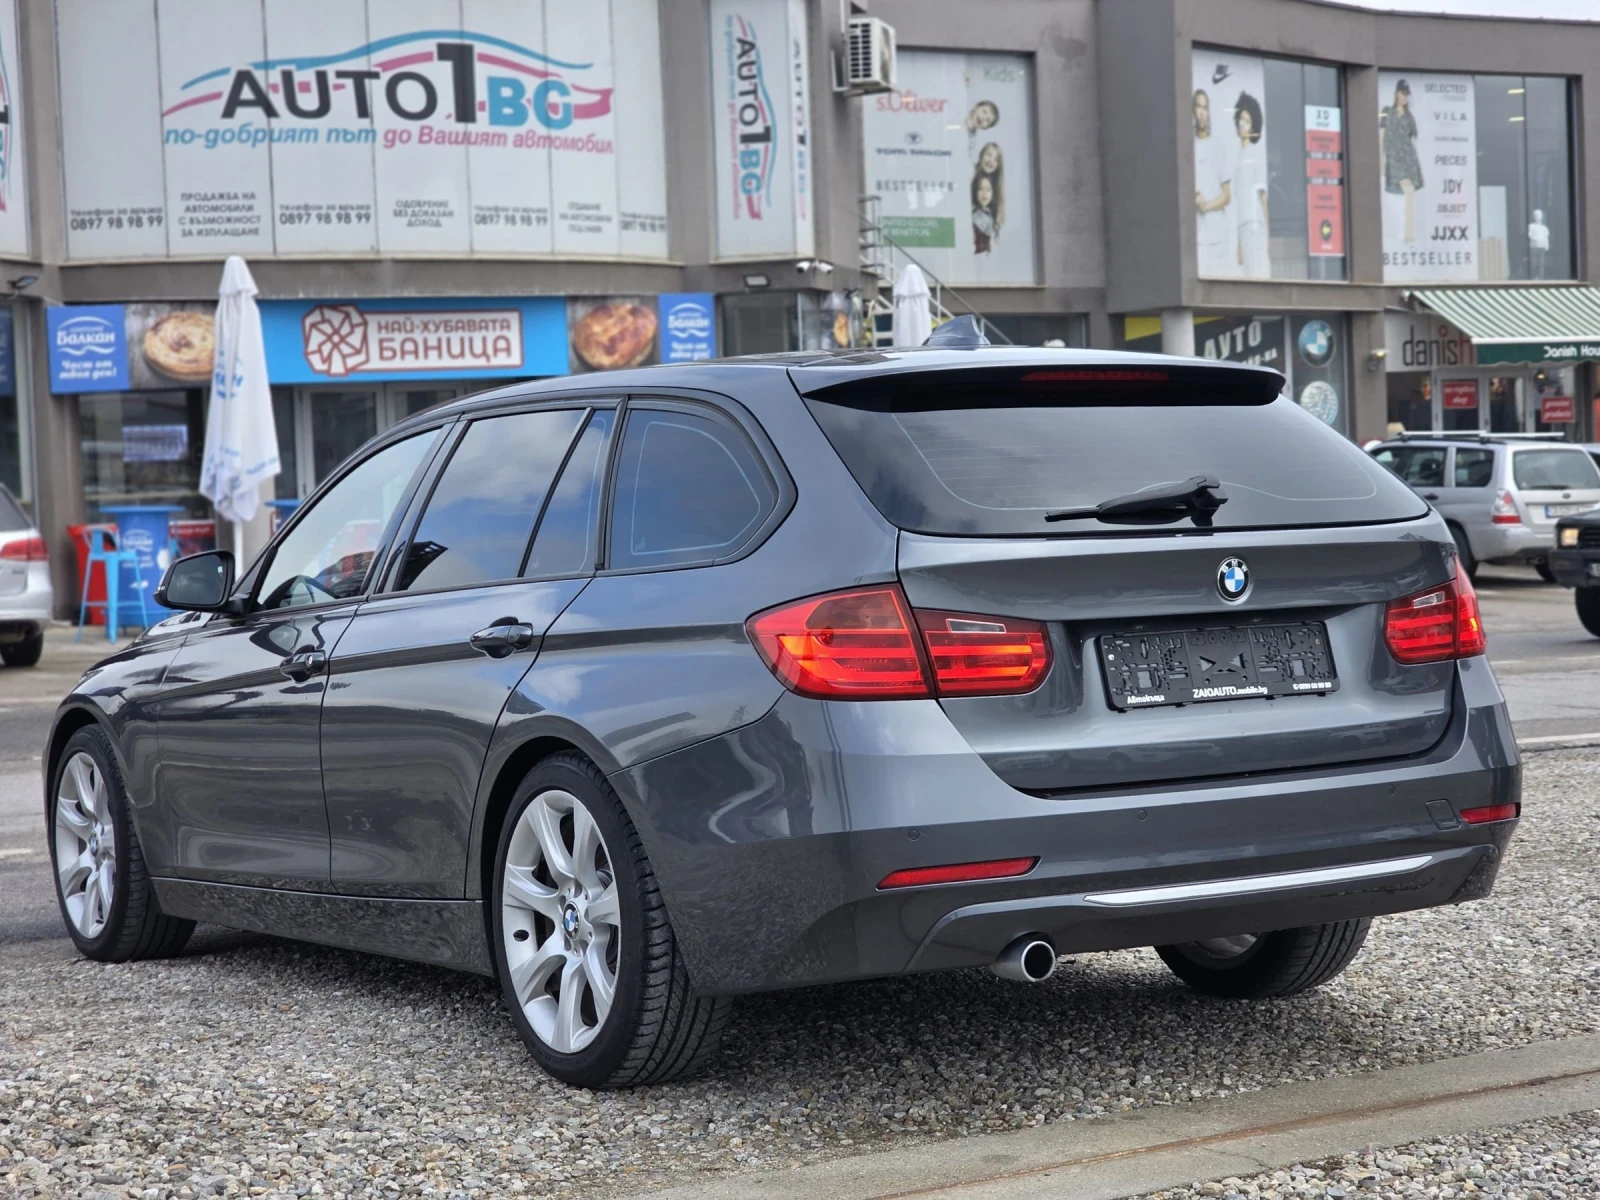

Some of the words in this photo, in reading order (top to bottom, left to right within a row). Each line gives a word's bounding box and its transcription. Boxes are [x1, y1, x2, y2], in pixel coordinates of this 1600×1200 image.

[1424, 84, 1467, 94] SELECTED
[1433, 111, 1468, 121] VILA
[164, 122, 319, 149] по-добрият
[326, 127, 377, 144] път
[383, 128, 412, 149] до
[418, 126, 508, 147] Вашият
[513, 129, 613, 154] автомобил
[1435, 154, 1467, 166] PIECES
[1442, 179, 1463, 194] JDY
[71, 217, 103, 231] 0897
[107, 216, 123, 229] 98
[127, 216, 143, 228] 98
[147, 215, 163, 228] 99
[279, 212, 311, 225] 0897
[316, 212, 332, 225] 98
[336, 212, 352, 225] 98
[356, 211, 371, 224] 99
[474, 213, 500, 226] 0897
[504, 214, 517, 226] 98
[520, 214, 533, 227] 98
[535, 214, 548, 227] 99
[1431, 226, 1469, 241] JJXX
[1382, 251, 1472, 266] BESTSELLER
[377, 317, 511, 334] НАЙ-ХУБАВАТА
[57, 331, 115, 345] Балкан
[1402, 324, 1474, 366] danish
[379, 335, 512, 362] БАНИЦА
